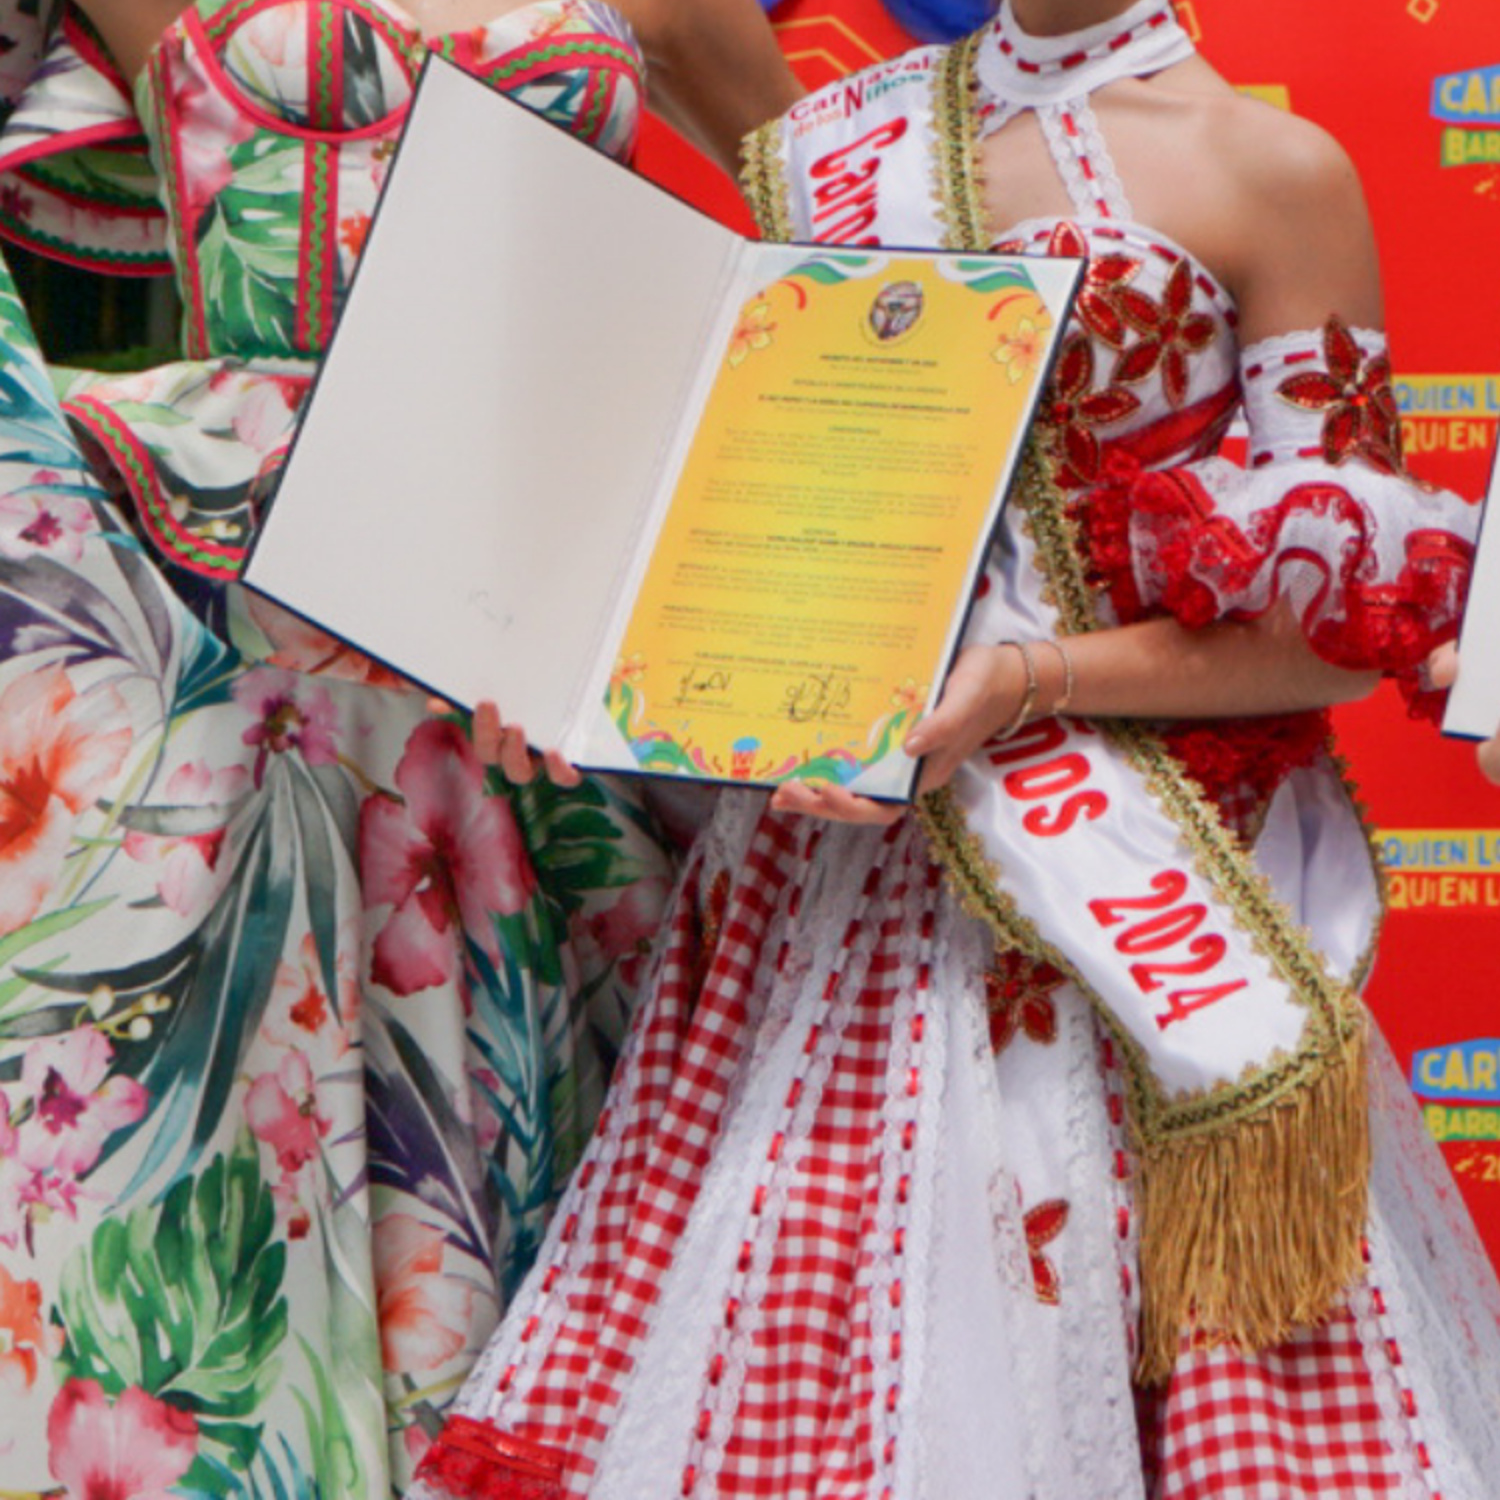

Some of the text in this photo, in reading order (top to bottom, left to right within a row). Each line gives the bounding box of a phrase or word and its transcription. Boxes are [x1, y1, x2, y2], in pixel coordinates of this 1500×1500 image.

[810, 116, 907, 245] Carn
[1086, 868, 1249, 1032] 2024
[1387, 875, 1477, 909] QUIEN
